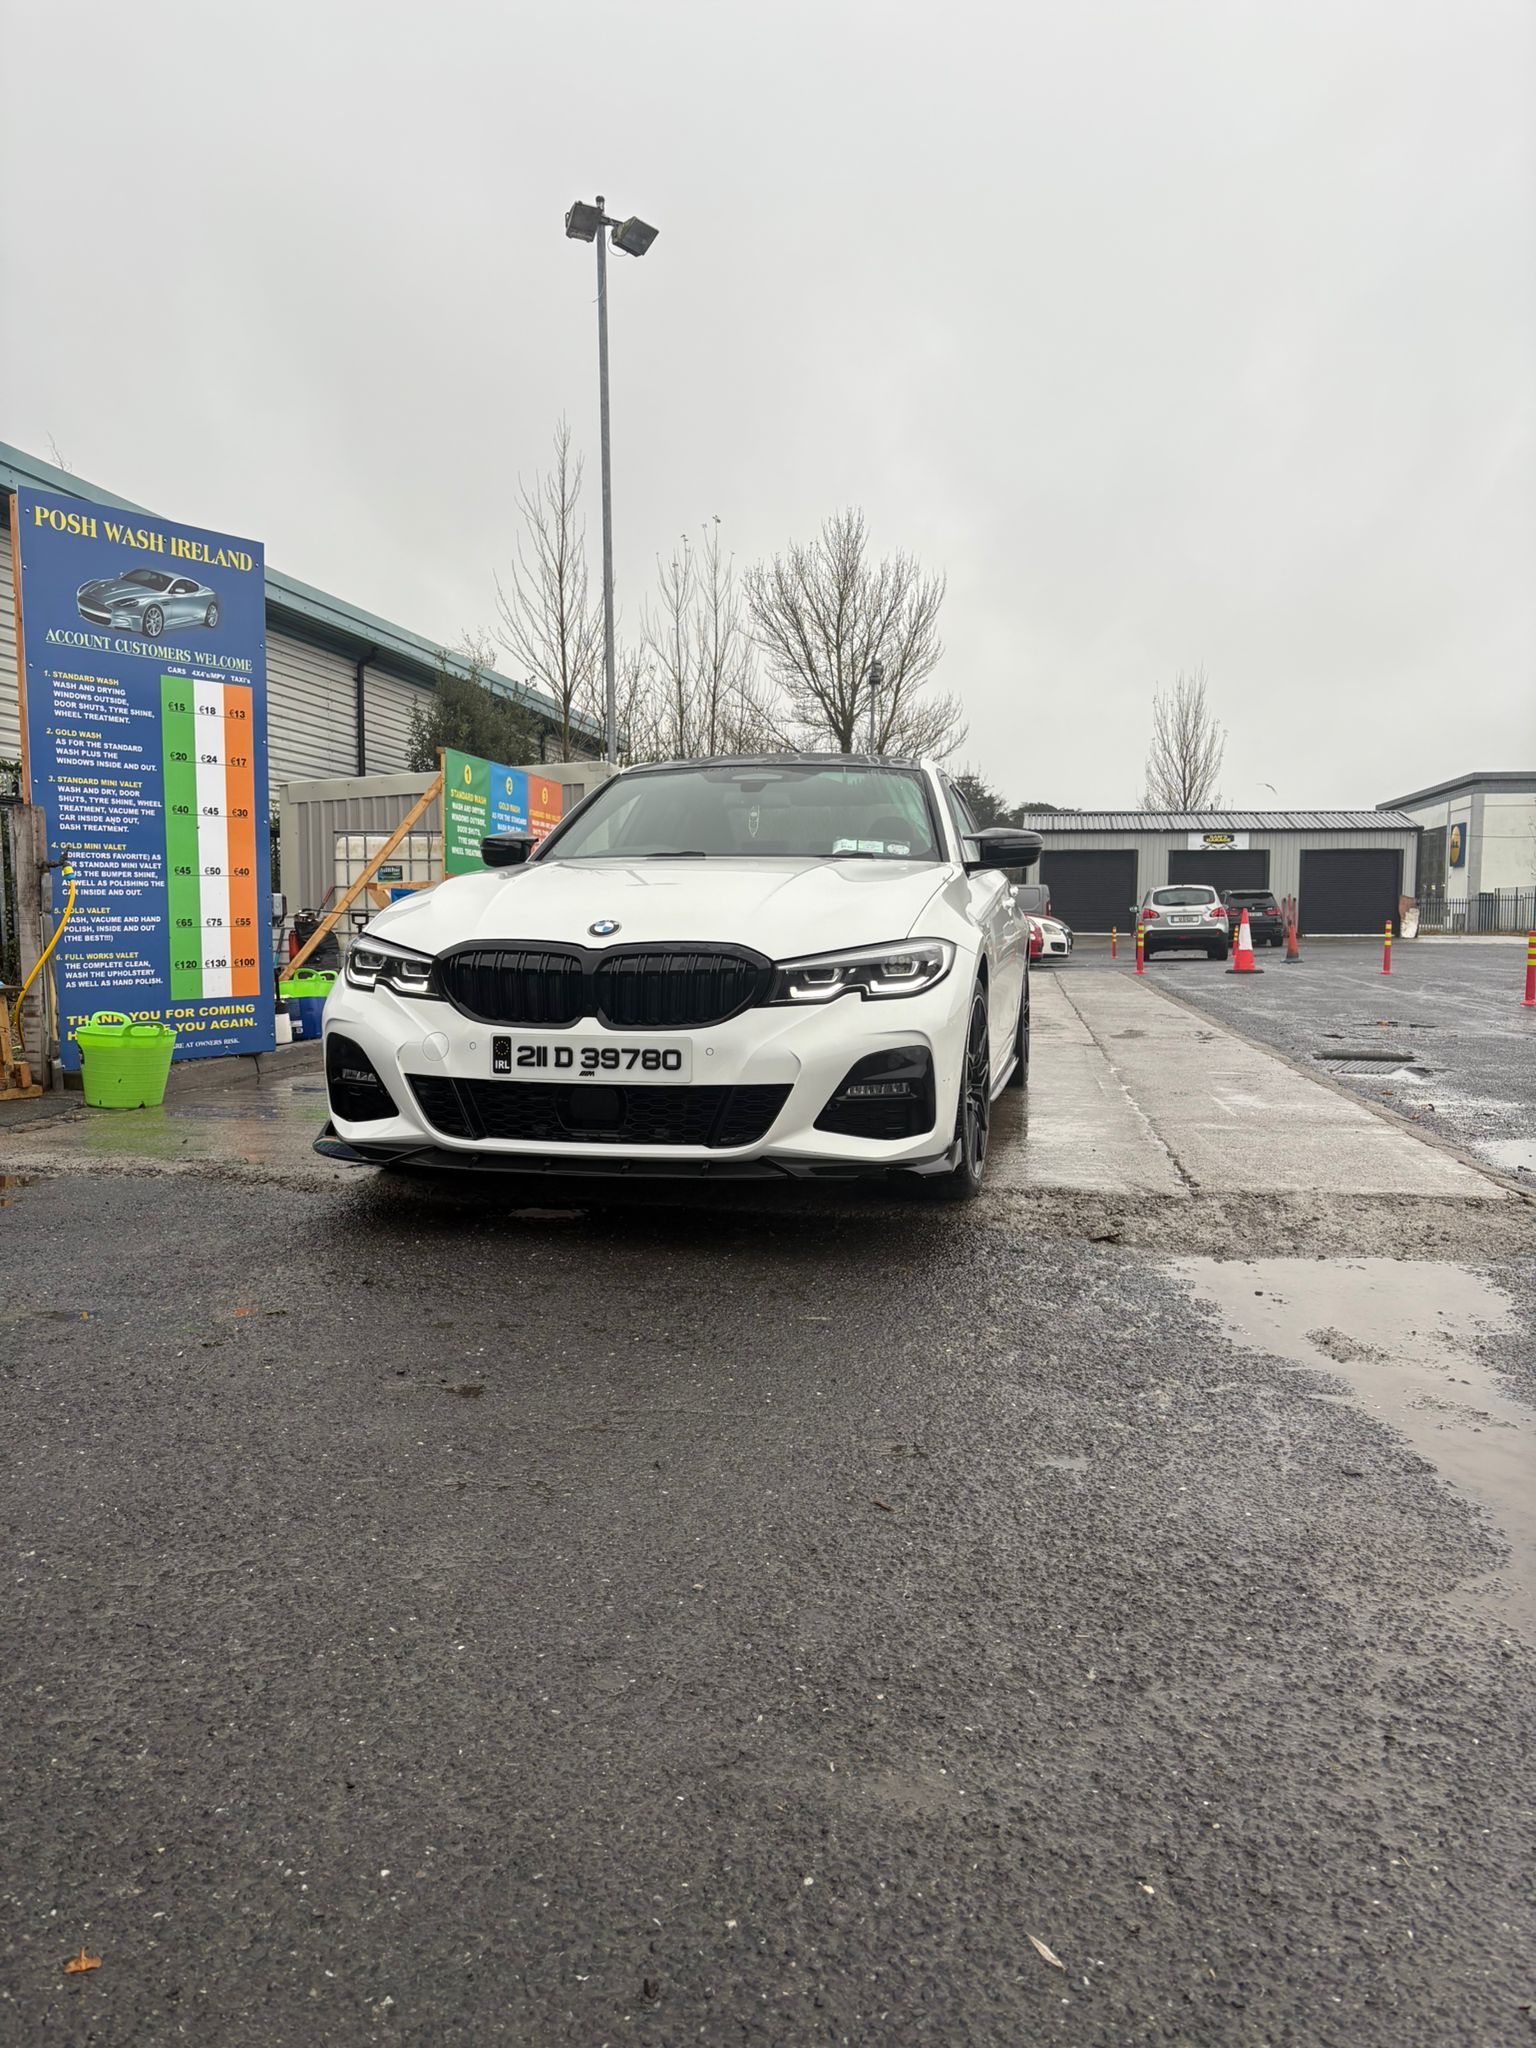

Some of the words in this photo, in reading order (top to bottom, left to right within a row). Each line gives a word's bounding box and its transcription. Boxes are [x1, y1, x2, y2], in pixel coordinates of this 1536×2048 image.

[35, 506, 96, 537] POSH
[104, 522, 165, 552] WASH
[171, 538, 252, 570] IRELAND
[46, 629, 110, 648] ACCOUNT
[115, 639, 190, 661] CUSTOMERS
[194, 652, 252, 670] WELCOME
[167, 666, 186, 674] CARS
[53, 671, 94, 682] STANDARD
[96, 677, 118, 685] WASH
[53, 680, 76, 689] WASH
[97, 686, 125, 695] DRYING
[53, 690, 91, 700] WINDOWS
[93, 695, 129, 705] OUTSIDE,
[54, 699, 76, 708] DOOR
[78, 702, 106, 712] SHUTS,
[108, 706, 128, 714] TYRE
[130, 709, 154, 718] SHINE,
[168, 701, 185, 711] €15
[199, 706, 216, 715] €18
[229, 709, 245, 718] €13
[54, 709, 81, 718] WHEEL
[84, 712, 130, 723] TREATMENT.
[54, 728, 78, 737] GOLD
[54, 737, 67, 745] AS
[103, 742, 142, 752] STANDARD
[56, 757, 94, 766] WINDOWS
[170, 751, 187, 760] €20
[201, 754, 217, 763] €24
[230, 757, 246, 766] €17
[57, 776, 98, 784] STANDARD
[58, 795, 87, 803] SHUTS,
[111, 798, 135, 806] SHINE,
[450, 789, 474, 802] STANDARD
[474, 795, 486, 804] WASH
[59, 804, 106, 813] TREATMENT,
[172, 805, 189, 813] €40
[202, 807, 218, 815] €45
[232, 808, 248, 817] €30
[59, 841, 82, 849] GOLD
[174, 866, 191, 874] €45
[234, 868, 249, 876] €40
[176, 918, 192, 927] €65
[206, 918, 222, 926] €75
[174, 960, 197, 969] €120
[205, 959, 226, 967] €130
[234, 958, 255, 966] €100
[130, 1008, 161, 1022] YOU
[165, 1008, 194, 1018] FOR
[199, 1004, 254, 1016] COMING
[175, 1020, 206, 1034] YOU
[210, 1018, 257, 1029] AGAIN.
[495, 1060, 510, 1070] IRL
[516, 1046, 548, 1067] 211
[554, 1046, 573, 1068] D
[580, 1048, 682, 1071] 39780
